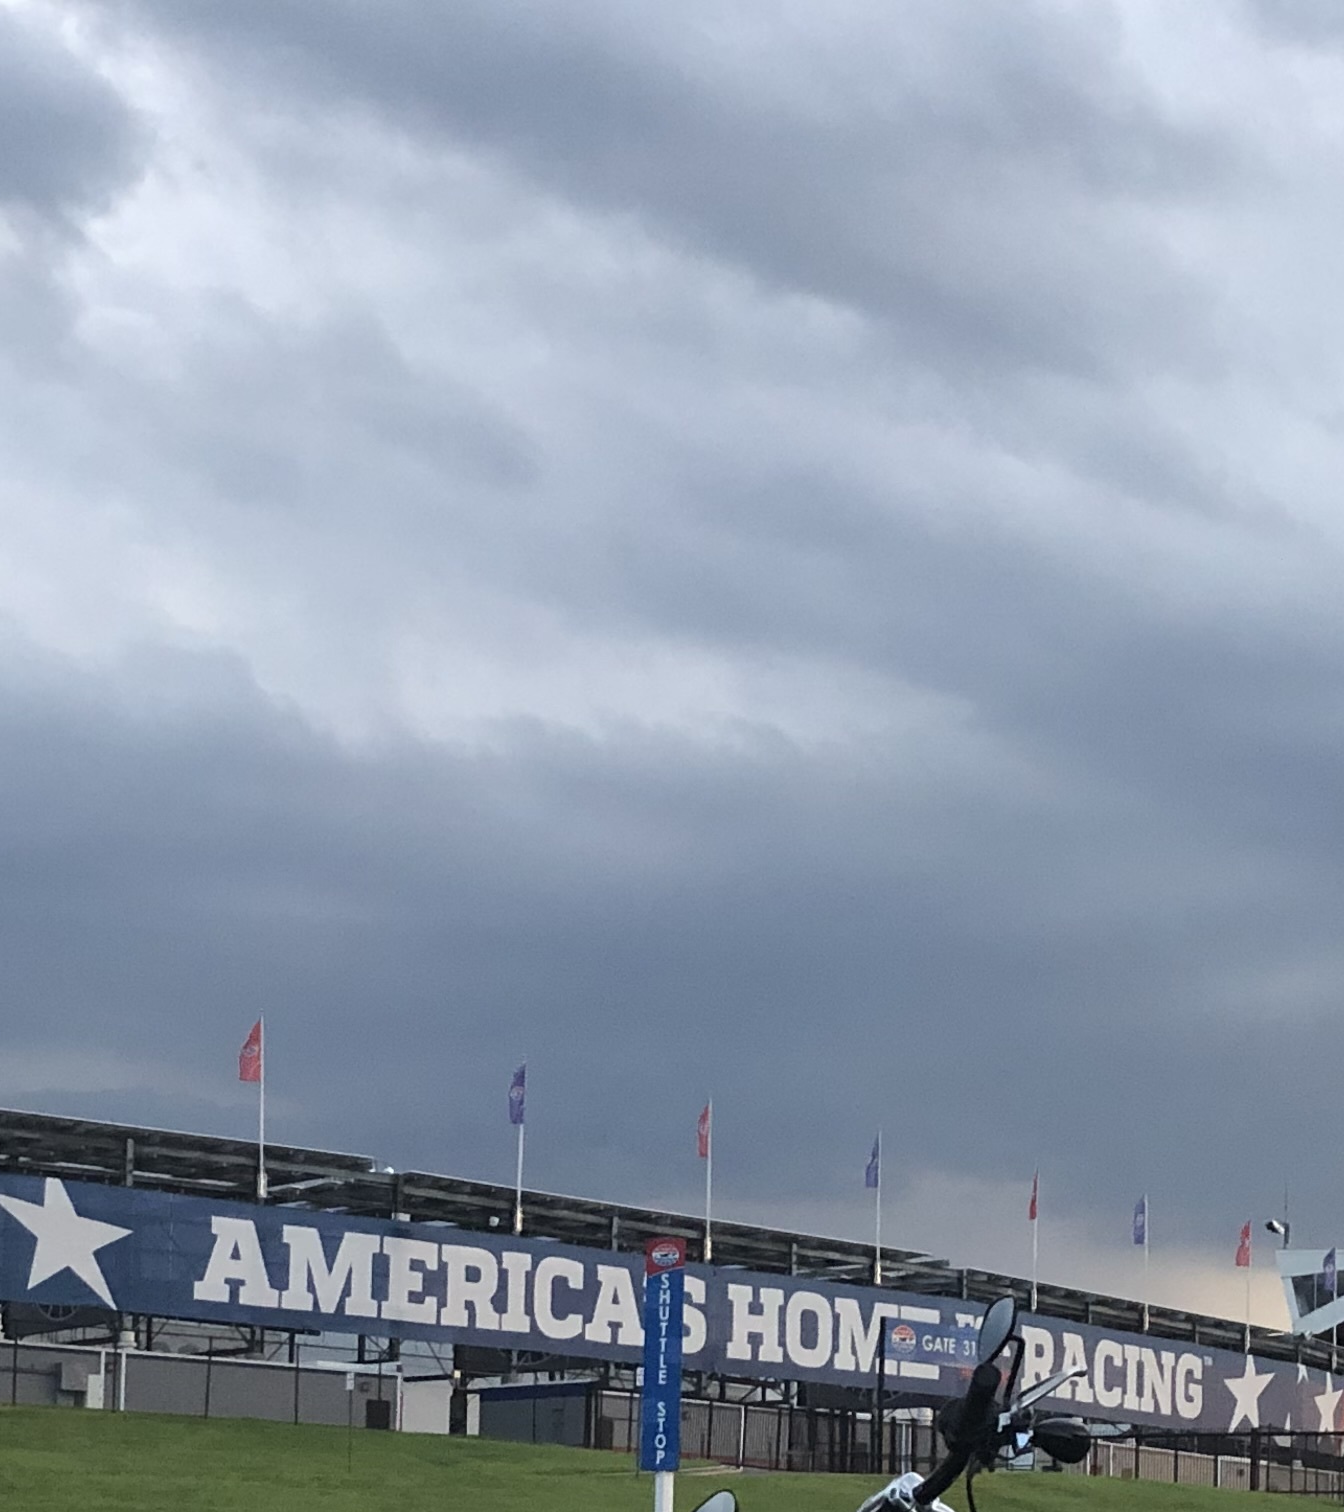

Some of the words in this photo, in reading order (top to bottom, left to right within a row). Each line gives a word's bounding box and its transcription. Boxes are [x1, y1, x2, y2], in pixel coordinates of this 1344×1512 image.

[658, 1273, 670, 1385] SHUTTLE
[922, 1334, 956, 1354] GATE
[963, 1340, 976, 1356] 31
[1020, 1325, 1202, 1419] RACING
[655, 1401, 667, 1465] STOP
